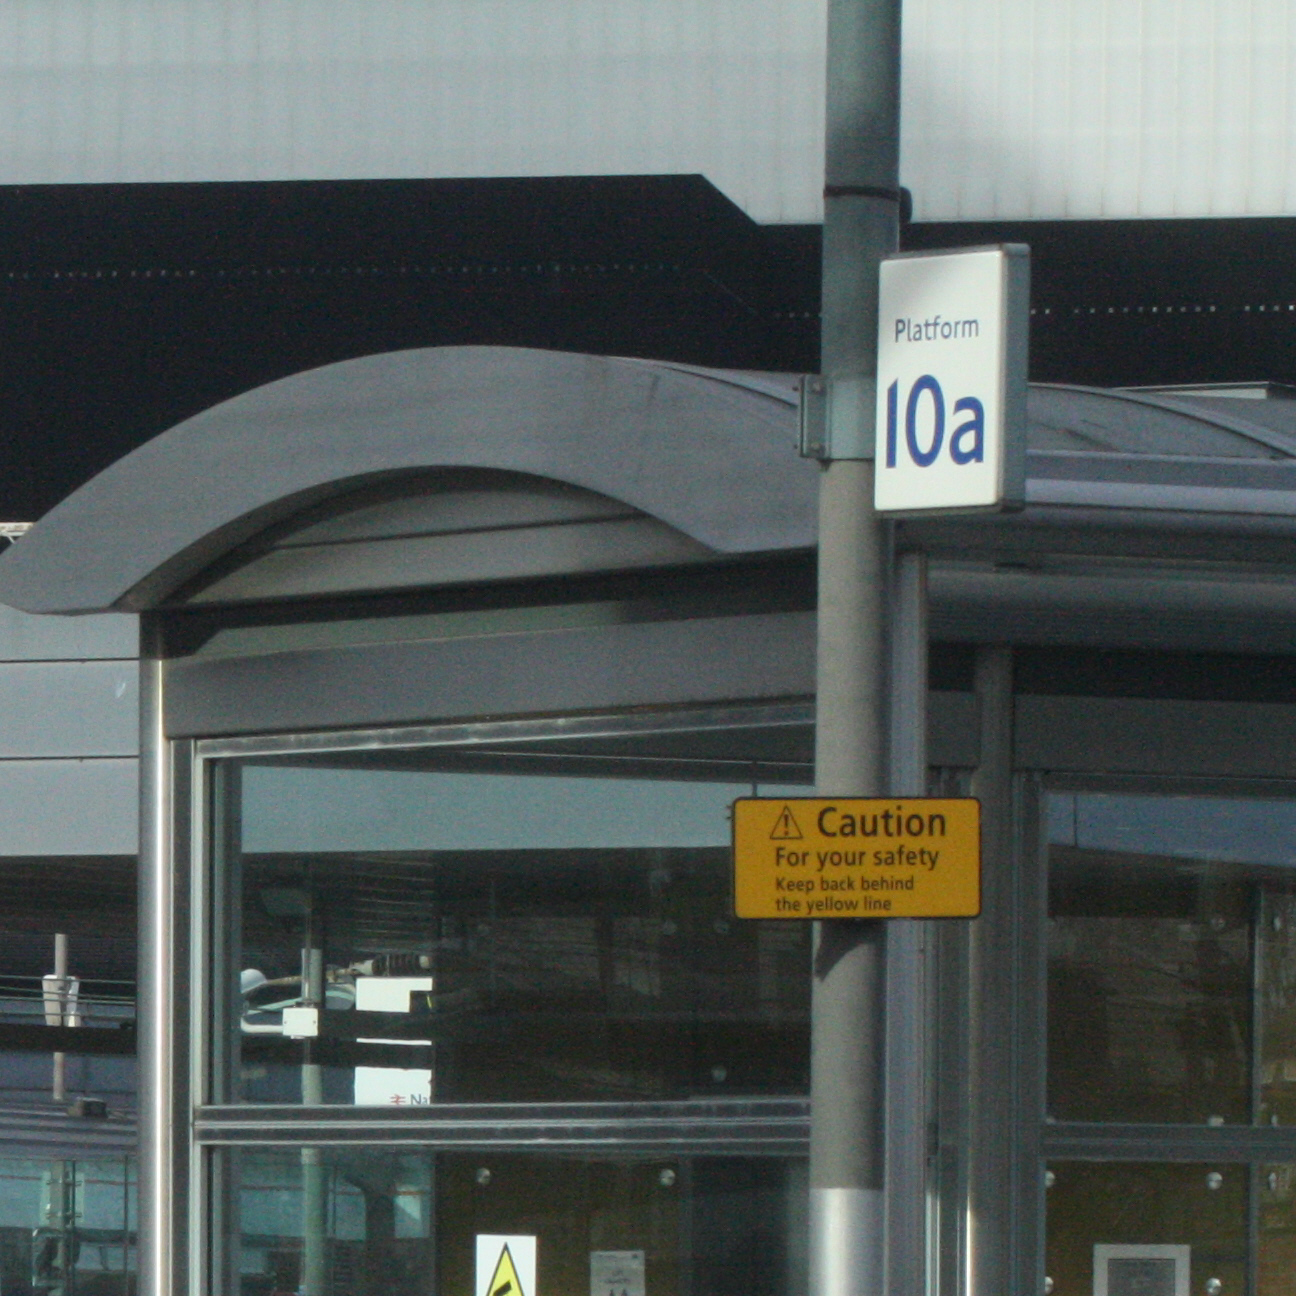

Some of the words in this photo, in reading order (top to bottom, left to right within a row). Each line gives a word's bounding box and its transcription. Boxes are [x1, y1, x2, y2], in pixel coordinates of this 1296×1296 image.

[895, 315, 979, 343] Platform
[886, 374, 985, 469] 10a
[817, 805, 946, 838] Caution
[775, 848, 809, 867] For
[817, 850, 866, 872] your
[874, 845, 939, 872] safety
[775, 876, 815, 894] Keep
[820, 876, 855, 891] back
[861, 876, 914, 891] behind
[775, 897, 801, 911] the
[806, 897, 858, 914] yellow
[864, 897, 892, 911] line
